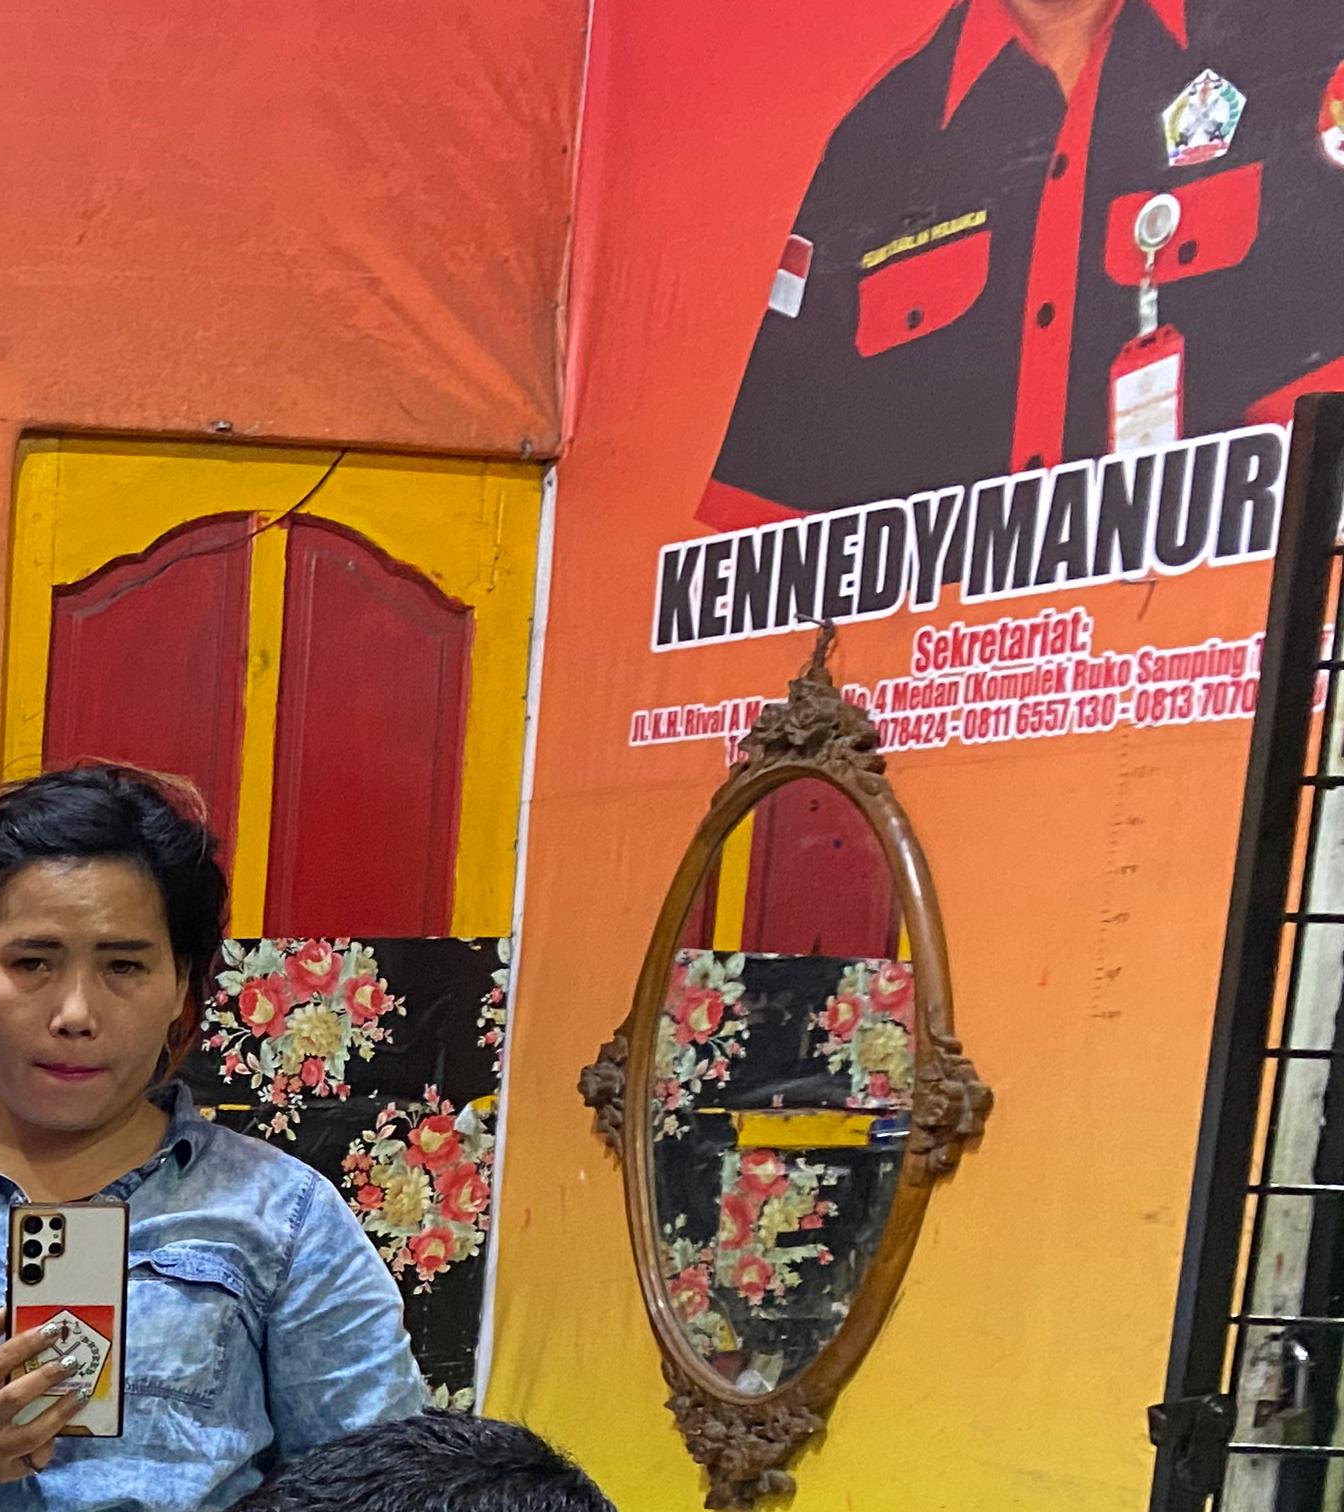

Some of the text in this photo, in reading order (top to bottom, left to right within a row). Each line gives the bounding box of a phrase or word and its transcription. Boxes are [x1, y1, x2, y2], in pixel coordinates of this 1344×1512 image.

[657, 431, 1284, 647] KENNEDY MANUR
[914, 610, 1091, 674] Sekretariat:
[684, 702, 725, 736] Rivai
[728, 701, 742, 731] A
[873, 680, 890, 714] 4
[891, 676, 961, 712] Medan
[963, 661, 1067, 705] (Komplek
[1071, 655, 1131, 693] Ruko
[1136, 643, 1245, 686] Samping
[876, 711, 947, 750] 078424
[963, 702, 1011, 740] 0811
[1016, 698, 1072, 736] 6557
[1075, 693, 1114, 729] 130
[1134, 684, 1193, 724] 0813
[1200, 679, 1258, 716] 7070
